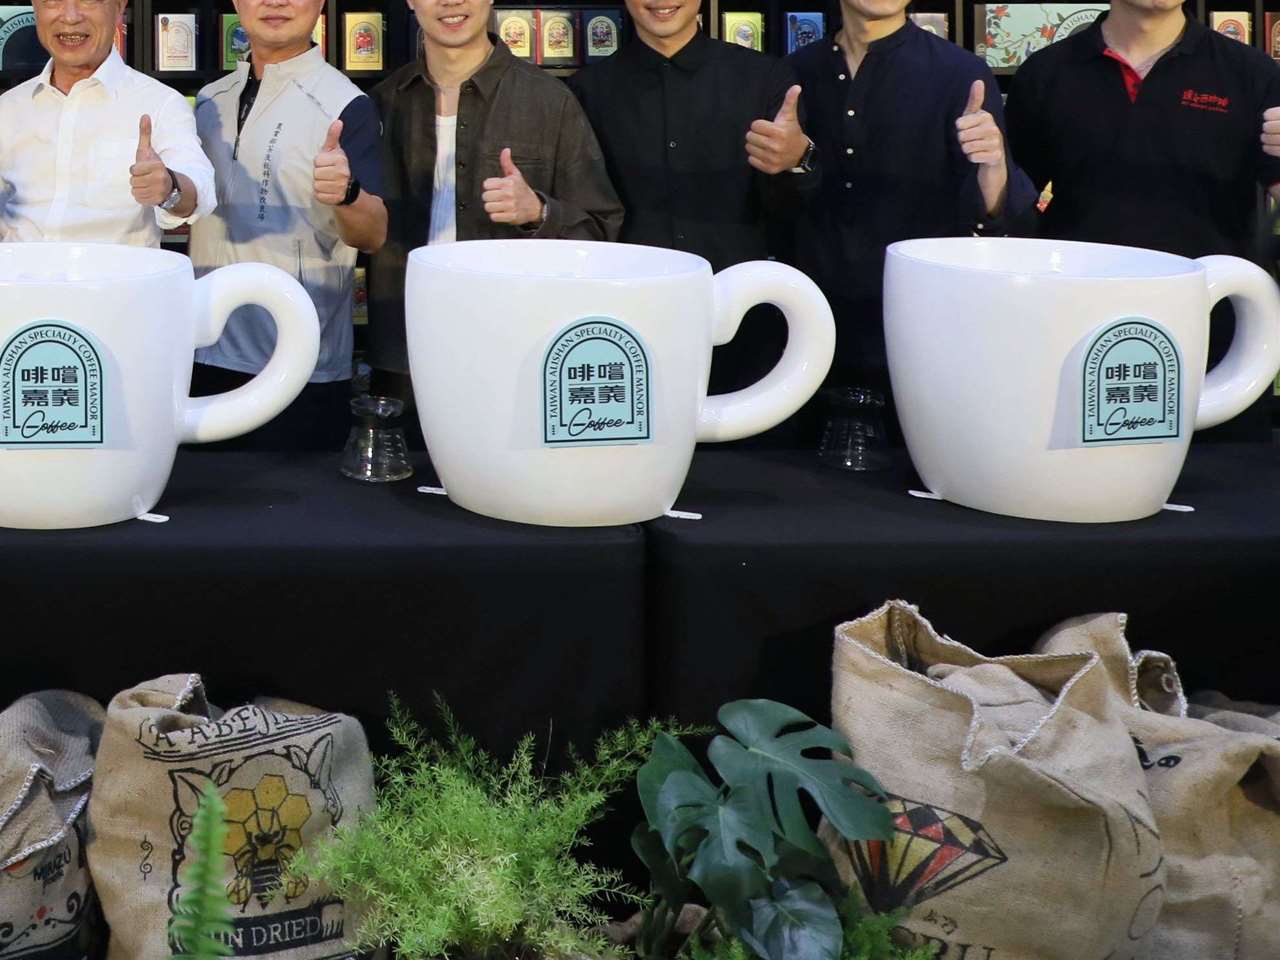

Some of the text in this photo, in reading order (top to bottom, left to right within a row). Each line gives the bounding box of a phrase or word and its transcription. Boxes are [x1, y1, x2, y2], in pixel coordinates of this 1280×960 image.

[2, 329, 99, 420] TAIWAN ALISHAN SPECIALTY COFFEE MANOR
[21, 365, 79, 384] 啡嚐
[549, 326, 645, 419] TAIWAN ALISHAN SPECIALTY COFFEE MANOR
[568, 362, 625, 381] 啡嚐
[1087, 327, 1176, 417] TAIWAN ALISHAN SPECIALTY COFFEE MANOR
[1105, 361, 1159, 381] 啡嚐
[21, 388, 79, 407] 嘉義
[568, 385, 626, 404] 嘉義
[1105, 384, 1159, 404] 嘉義
[21, 410, 79, 439] Coffee
[568, 407, 625, 436] Coffee
[1104, 407, 1157, 436] Coffee
[251, 915, 321, 947] DRIED
